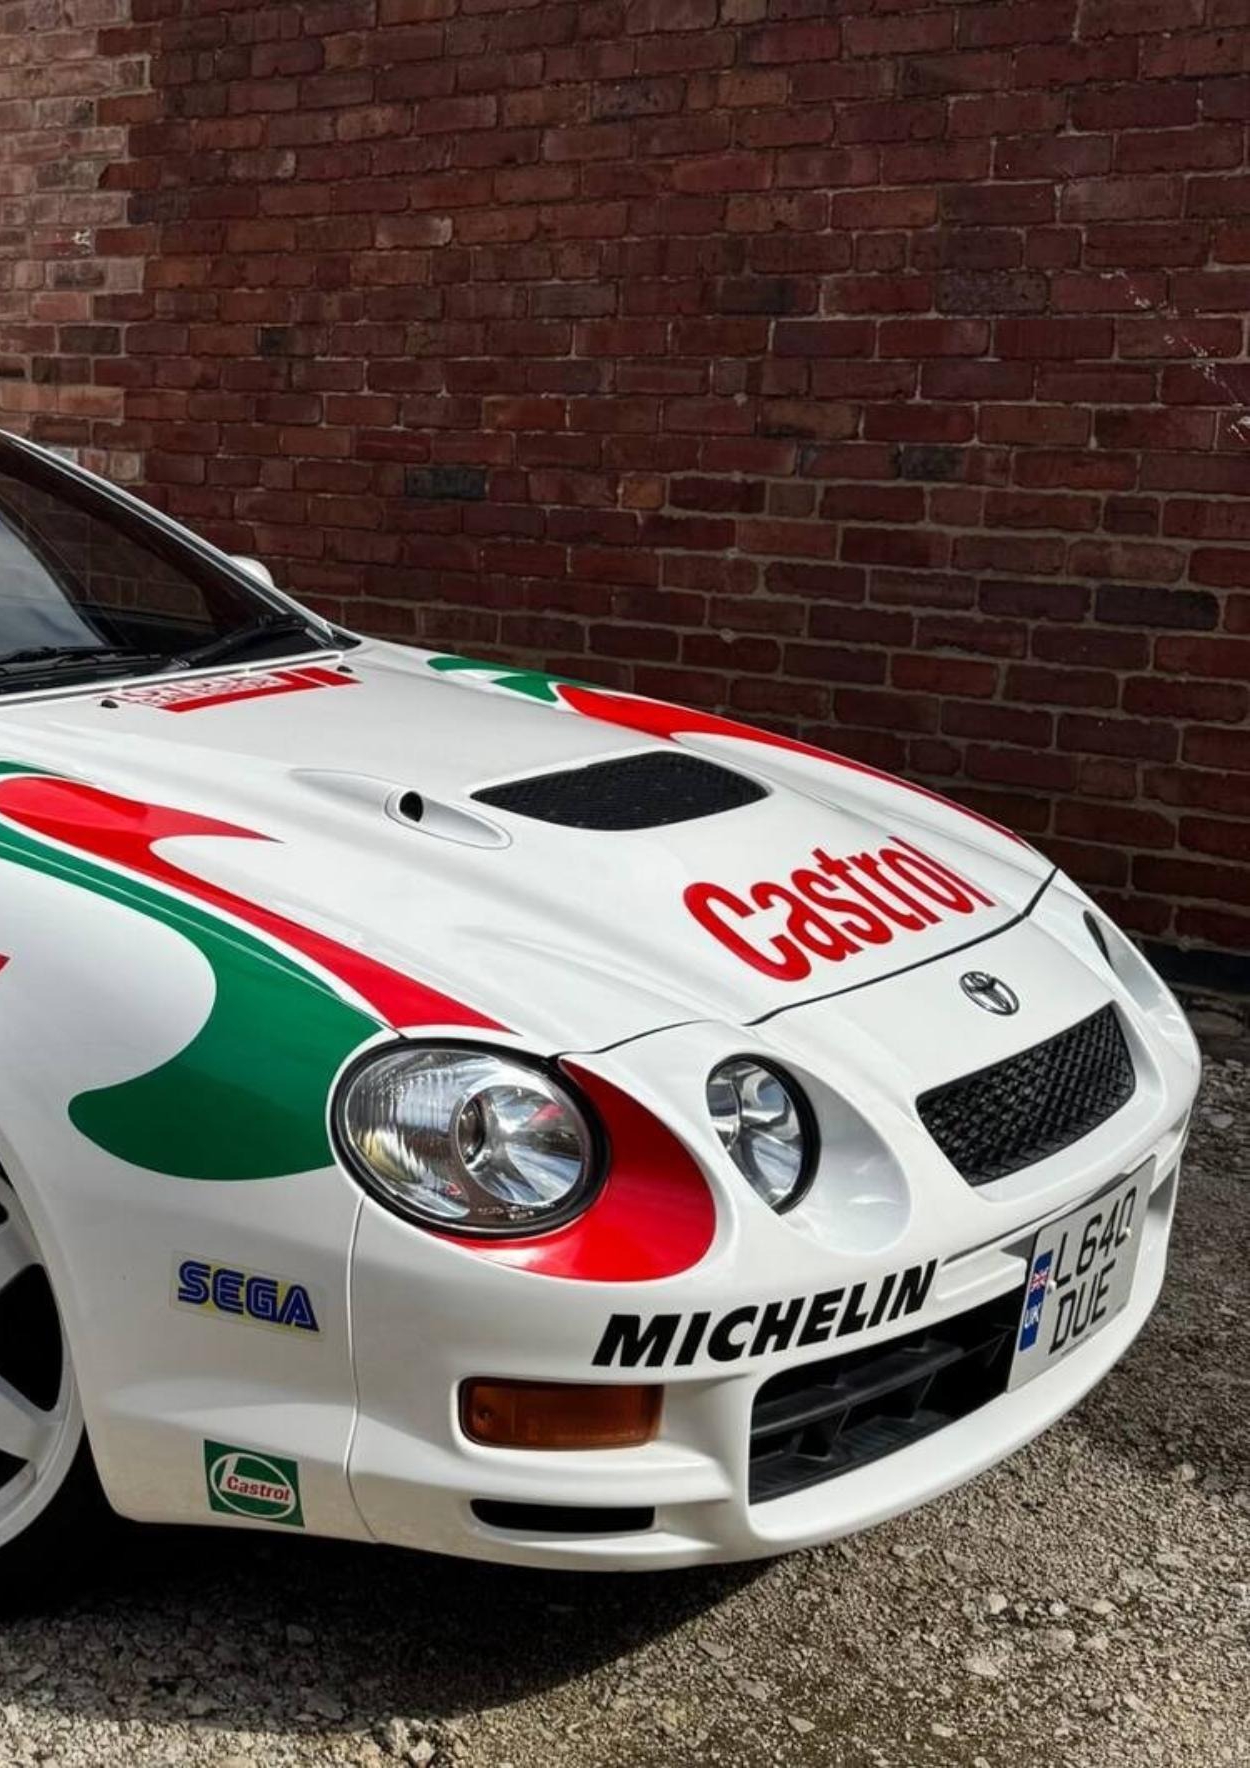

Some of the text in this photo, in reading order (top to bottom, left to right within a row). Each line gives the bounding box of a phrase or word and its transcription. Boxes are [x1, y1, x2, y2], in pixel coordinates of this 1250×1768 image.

[682, 835, 997, 982] Castrol
[1054, 1186, 1137, 1290] L640
[177, 1260, 320, 1332] SEGA
[592, 1259, 939, 1367] MICHELIN
[1023, 1303, 1042, 1329] UK
[1049, 1258, 1116, 1356] DUE
[227, 1475, 290, 1501] Castrol
